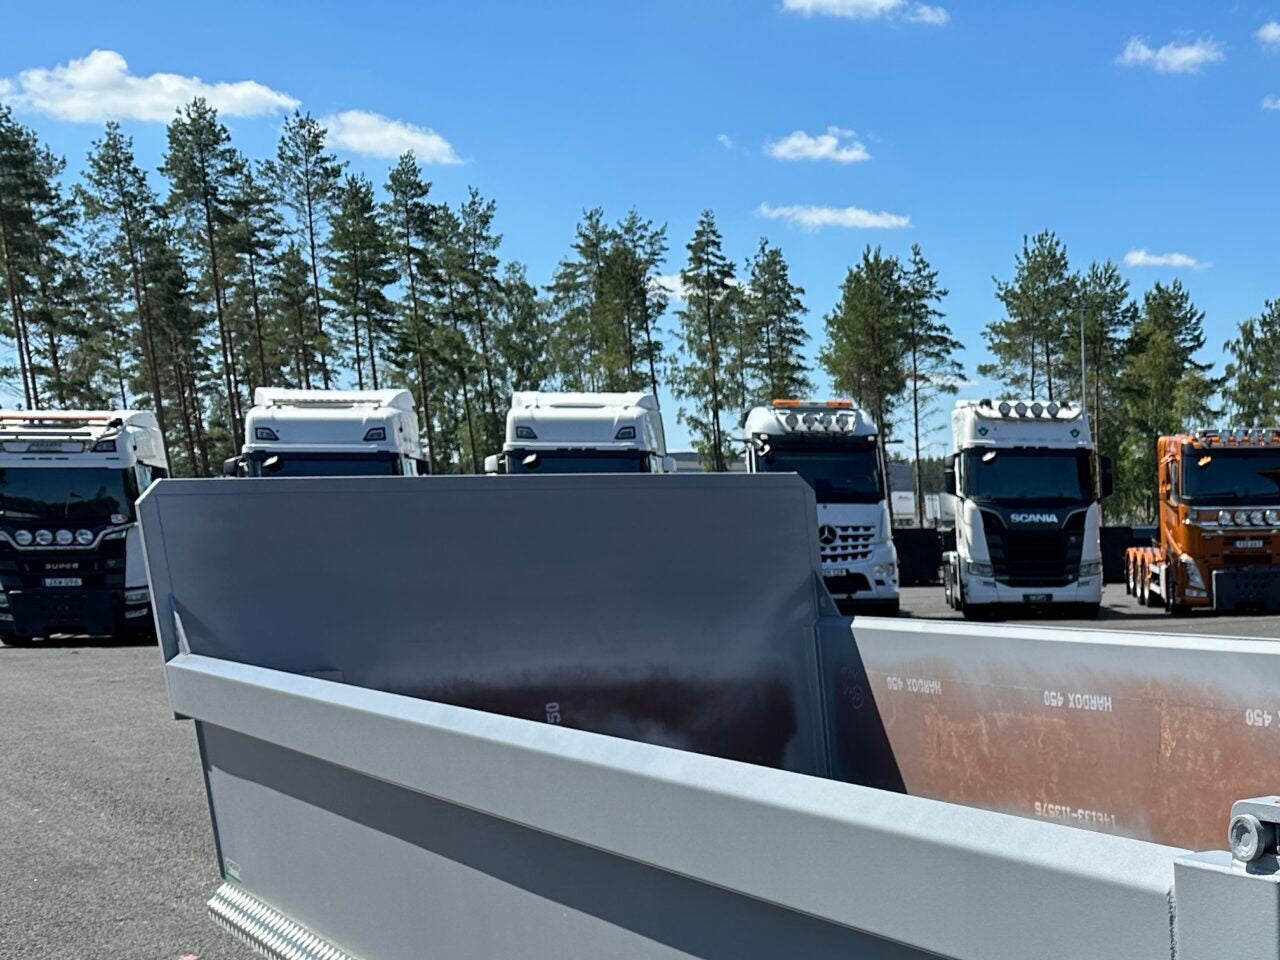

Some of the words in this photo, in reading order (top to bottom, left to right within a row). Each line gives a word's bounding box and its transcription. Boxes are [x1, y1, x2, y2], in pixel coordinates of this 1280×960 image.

[1010, 513, 1058, 523] SCANIA
[887, 676, 904, 691] 450
[906, 678, 942, 695] HARDOX
[1043, 690, 1064, 707] 450
[1067, 692, 1112, 712] HARDOX
[1245, 708, 1272, 727] 450
